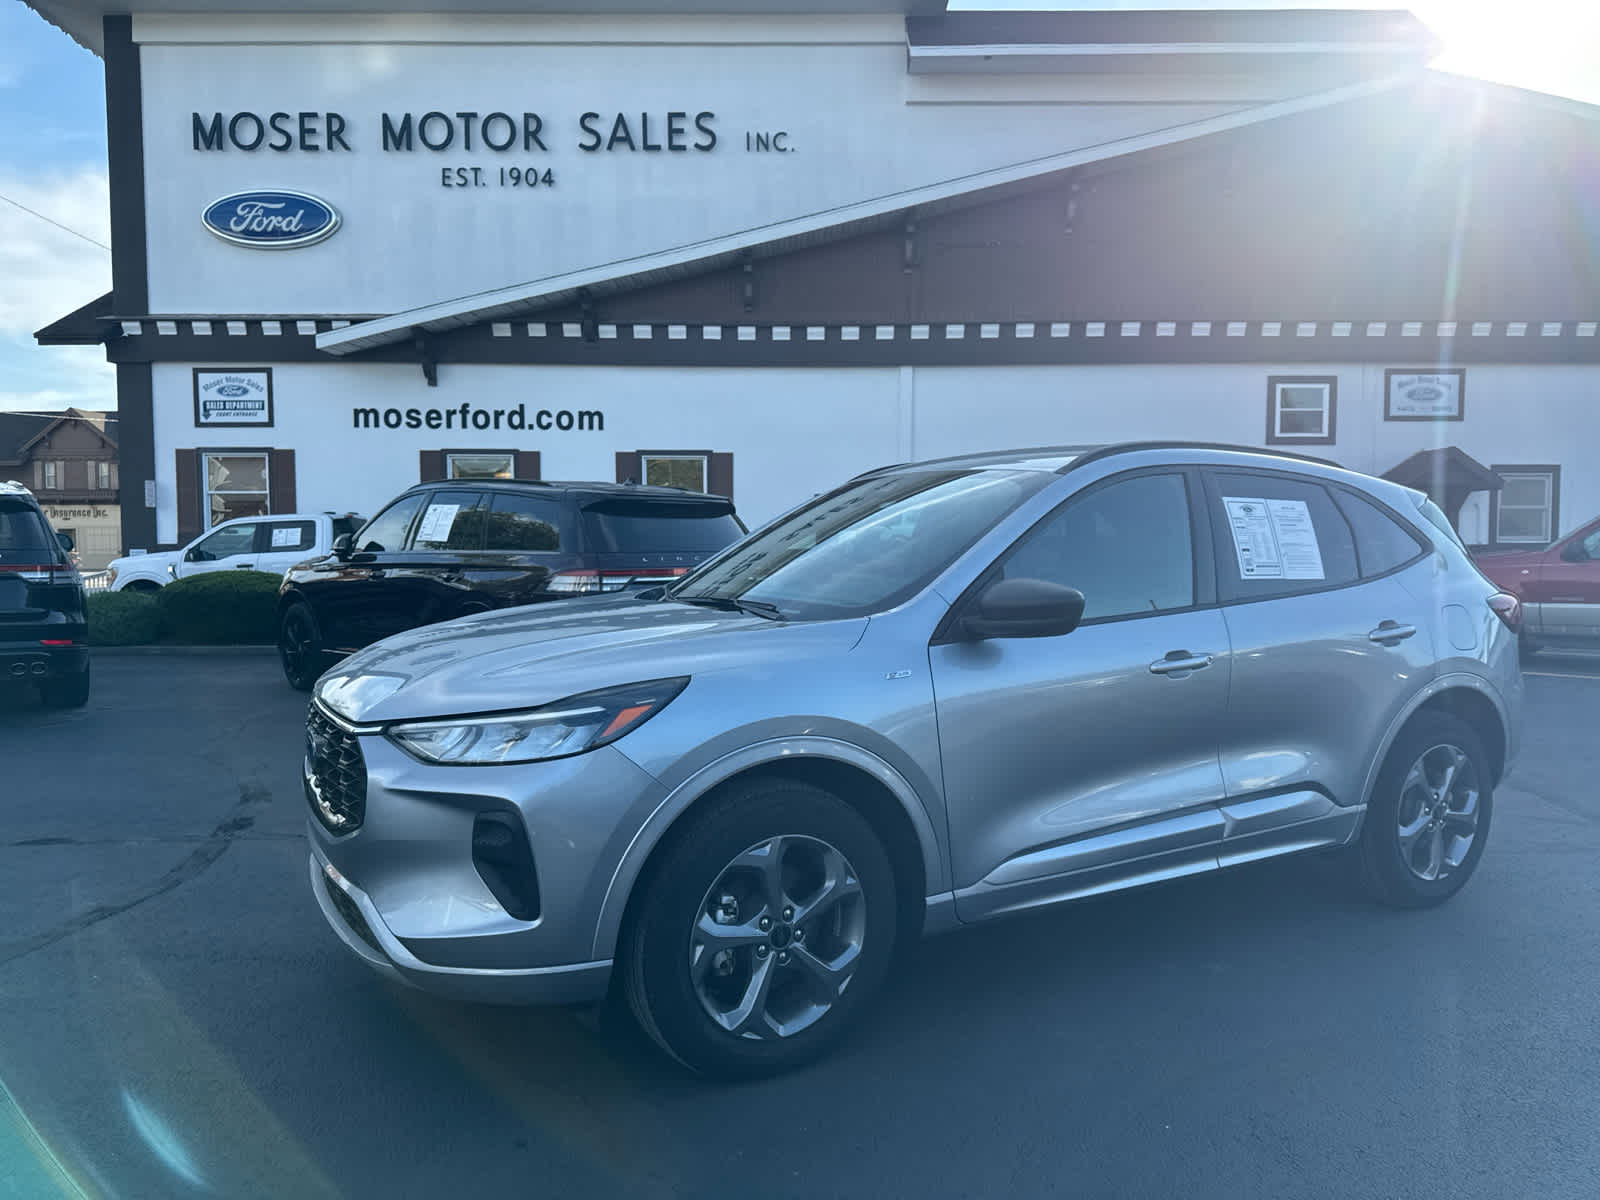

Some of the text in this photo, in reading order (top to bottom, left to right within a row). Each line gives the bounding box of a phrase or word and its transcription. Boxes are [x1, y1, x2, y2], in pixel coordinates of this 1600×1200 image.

[192, 111, 795, 153] MOSER MOTOR SALES INC.
[441, 167, 555, 187] EST. 1904
[229, 201, 304, 232] Ford
[225, 376, 246, 384] Motor
[206, 401, 264, 409] SALES DEPARTMENT
[353, 403, 604, 431] moserford.com
[50, 506, 91, 518] Insurance
